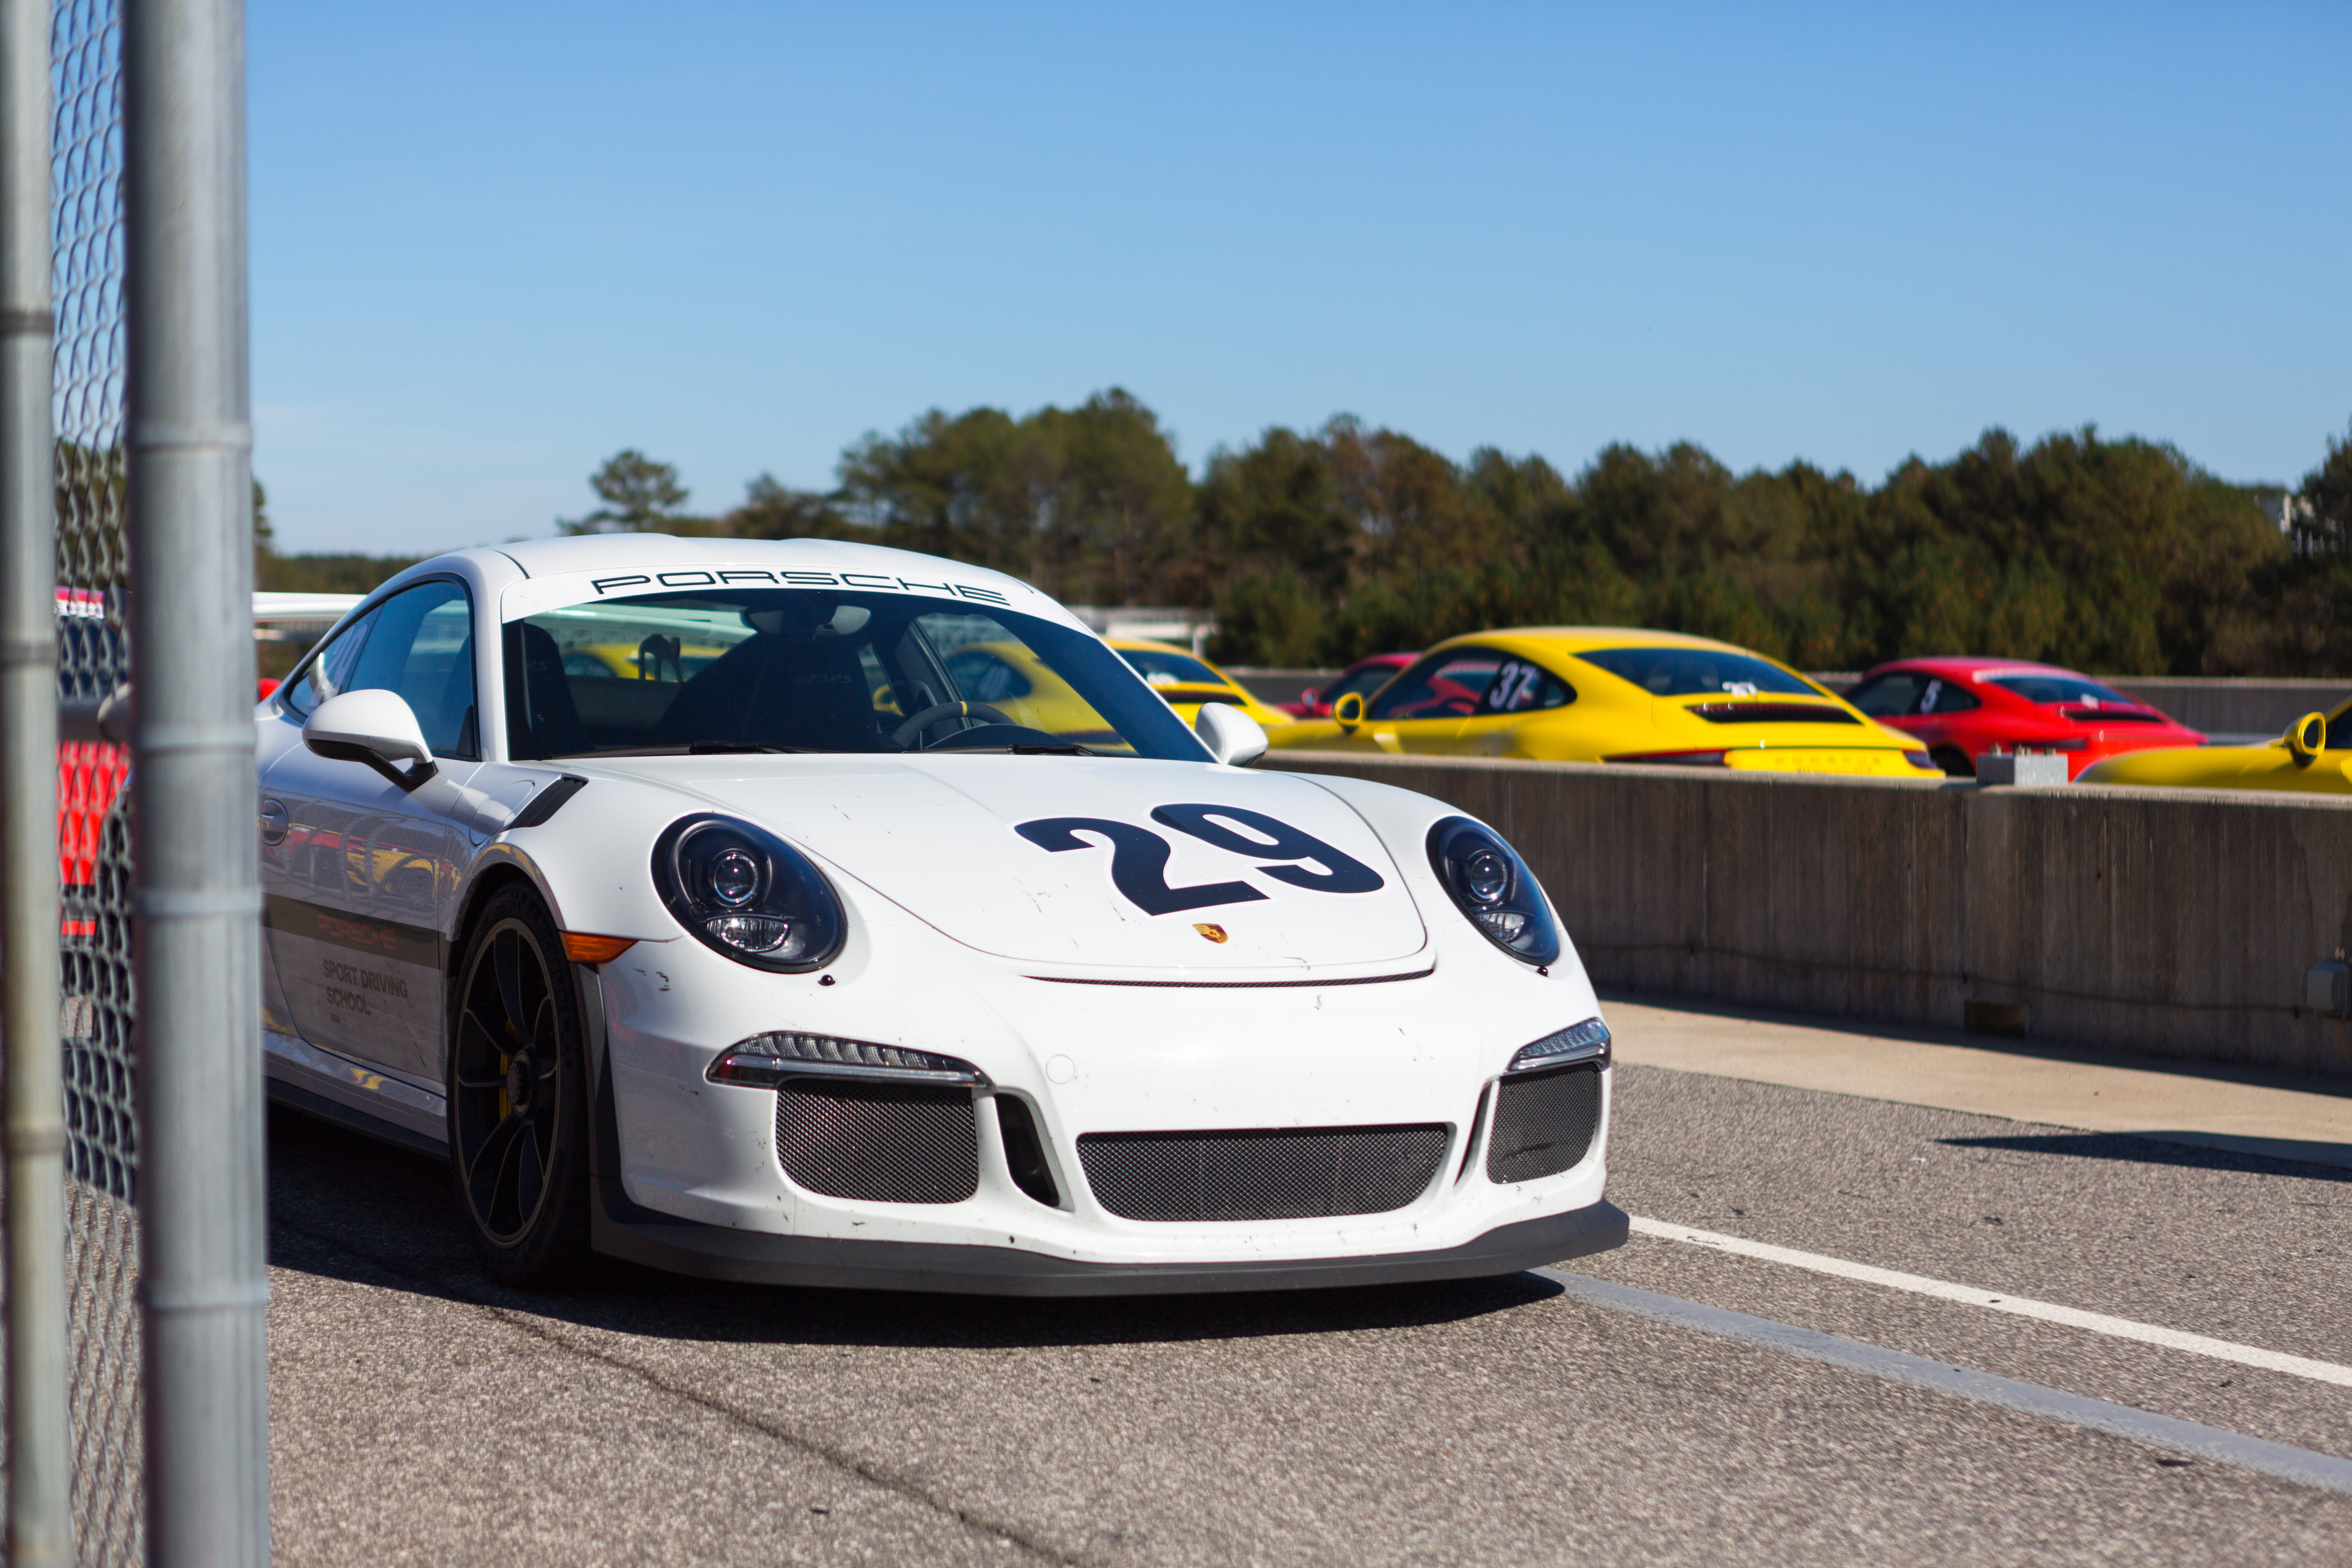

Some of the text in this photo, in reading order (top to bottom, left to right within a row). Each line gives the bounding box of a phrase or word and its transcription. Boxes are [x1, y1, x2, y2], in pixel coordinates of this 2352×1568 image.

[590, 570, 1011, 606] PORSCHE
[1490, 662, 1536, 711] 37
[1014, 804, 1385, 916] 29
[318, 914, 396, 950] PORSCHE
[323, 958, 408, 1000] SPORT DRIVING
[535, 916, 566, 1009] MICHELIN
[326, 986, 371, 1016] SCHOOL
[330, 1013, 340, 1022] USA
